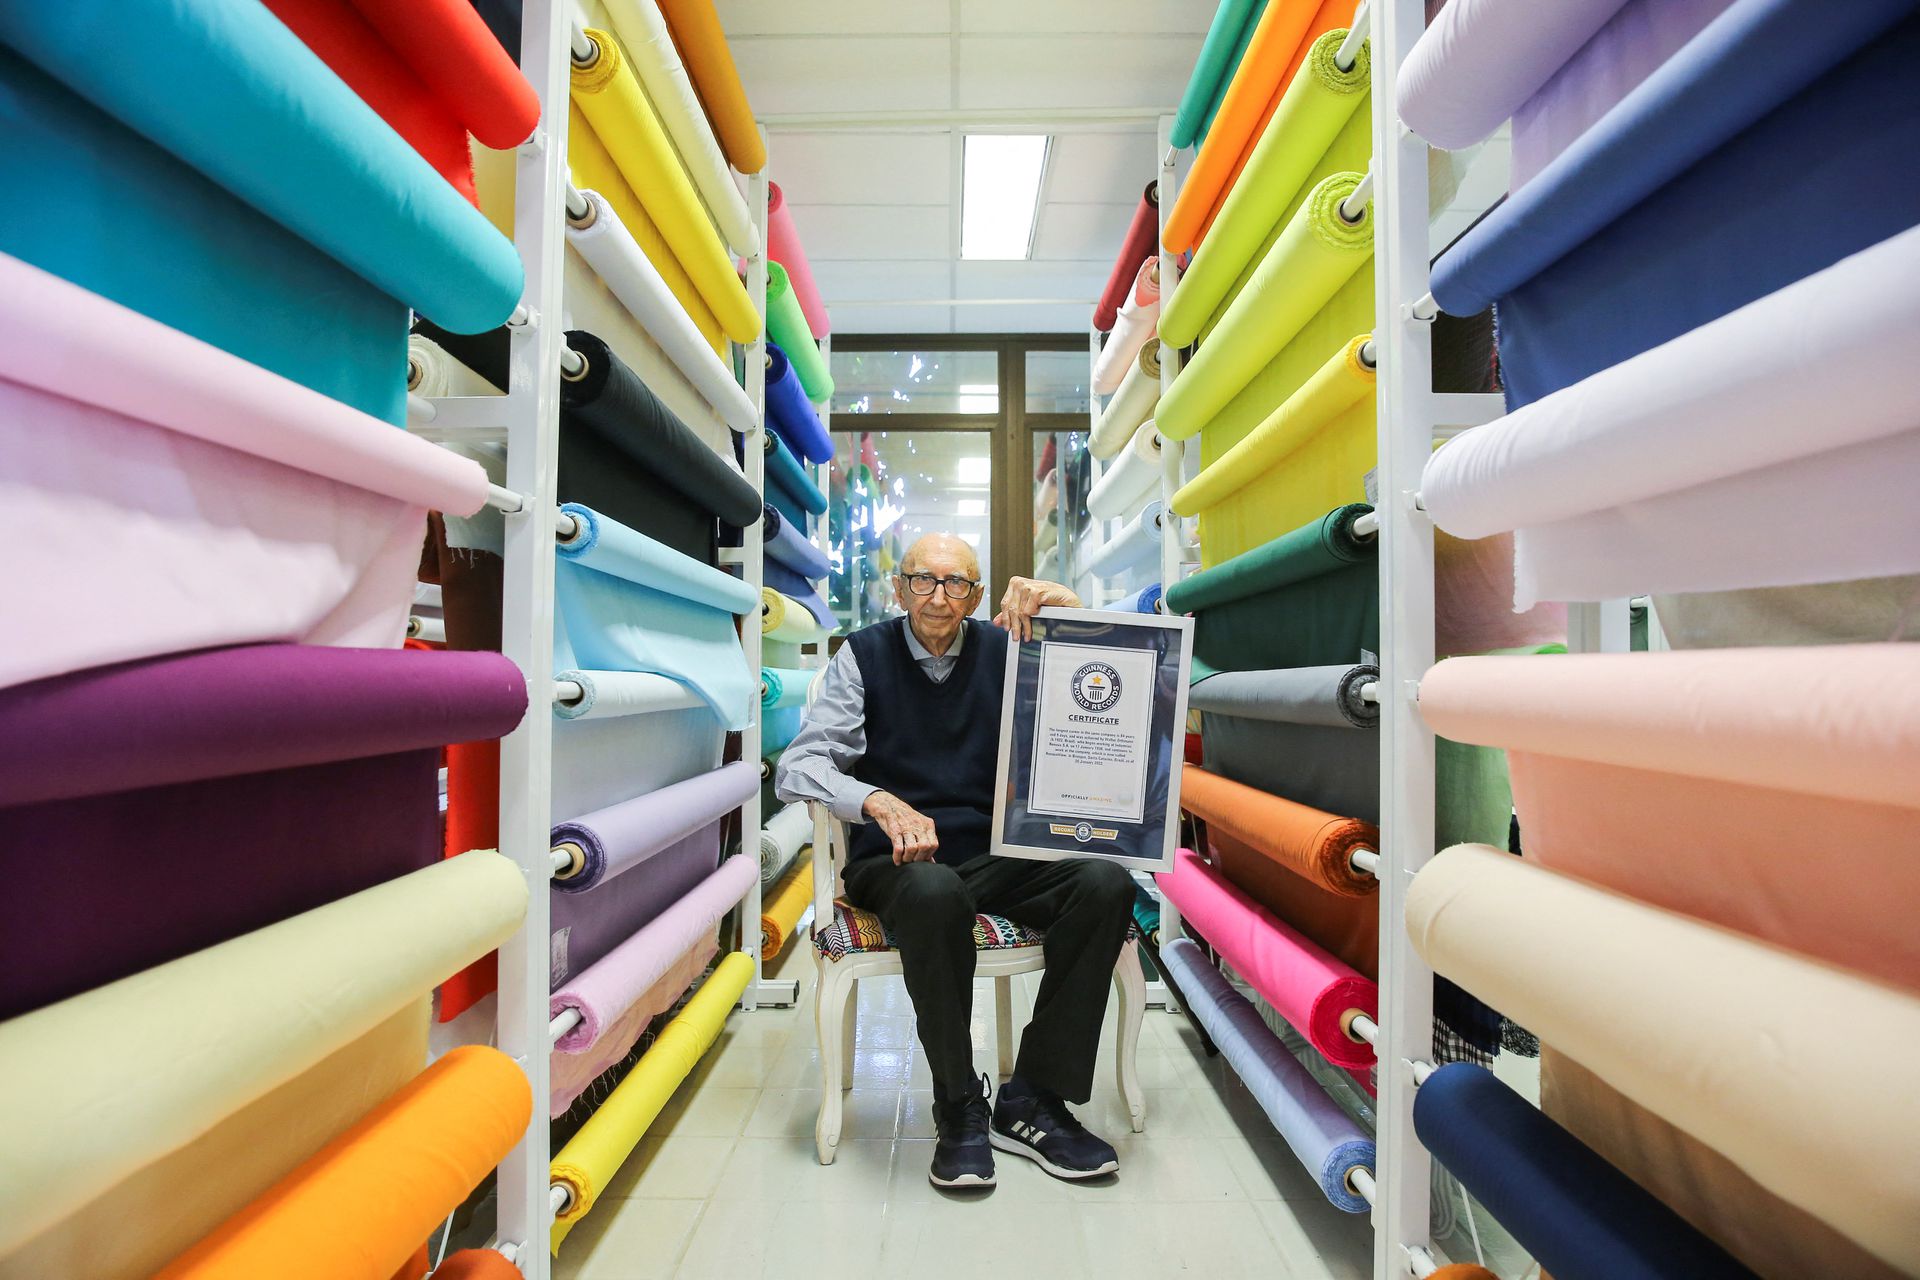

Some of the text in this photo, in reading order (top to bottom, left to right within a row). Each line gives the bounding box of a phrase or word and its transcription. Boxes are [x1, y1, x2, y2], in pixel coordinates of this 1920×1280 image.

[1079, 664, 1116, 680] GUINNESS
[1073, 682, 1120, 710] WORLD RECORDS
[1068, 714, 1120, 725] CERTIFICATE
